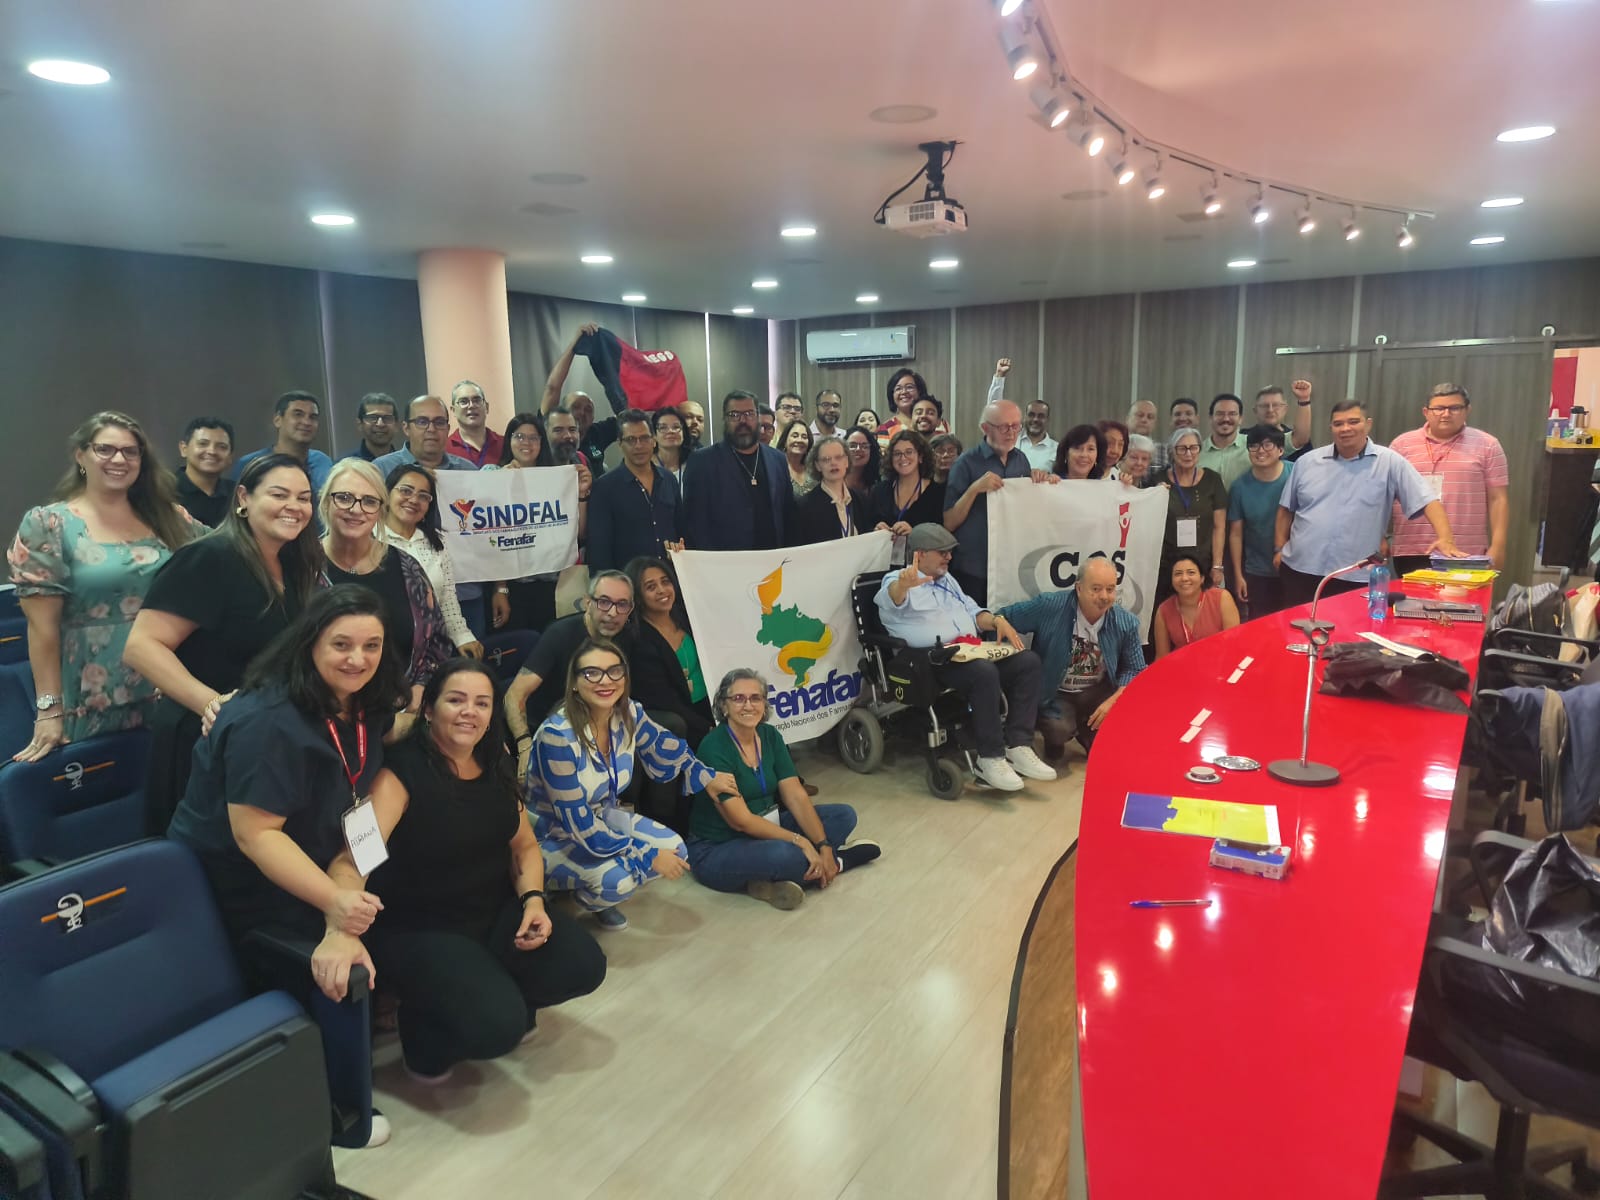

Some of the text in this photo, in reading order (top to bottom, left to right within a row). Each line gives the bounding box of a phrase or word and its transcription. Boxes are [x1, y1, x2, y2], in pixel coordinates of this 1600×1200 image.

[472, 499, 568, 529] SINDFAL
[497, 533, 537, 548] Fenafar
[791, 714, 817, 728] Nacional
[816, 709, 829, 719] dos
